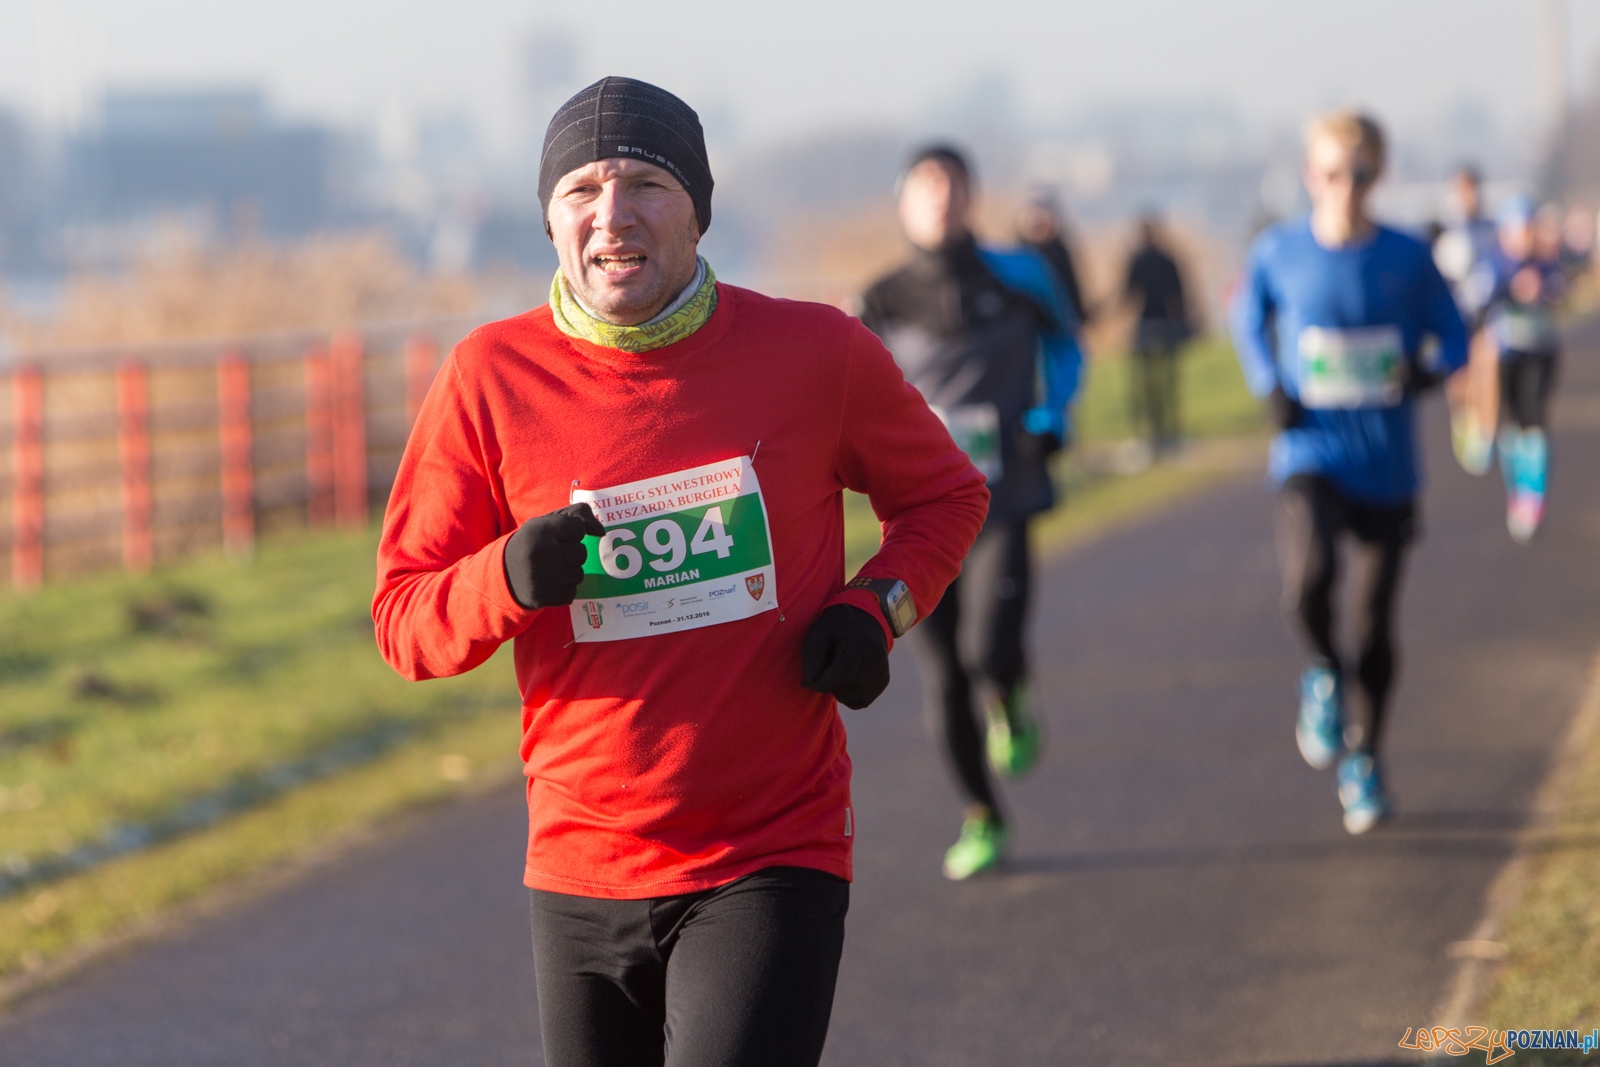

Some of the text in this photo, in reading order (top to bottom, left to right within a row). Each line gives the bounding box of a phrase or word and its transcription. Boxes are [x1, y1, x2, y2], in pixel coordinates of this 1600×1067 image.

[606, 500, 675, 522] RYSZARDA
[677, 483, 741, 506] BURGIELA
[613, 490, 646, 506] BIEG
[647, 467, 742, 498] SYLWESTROWY
[598, 505, 735, 579] 694
[644, 568, 701, 589] MARIAN
[649, 618, 672, 627] Poznań
[676, 611, 711, 622] 31.12.2016
